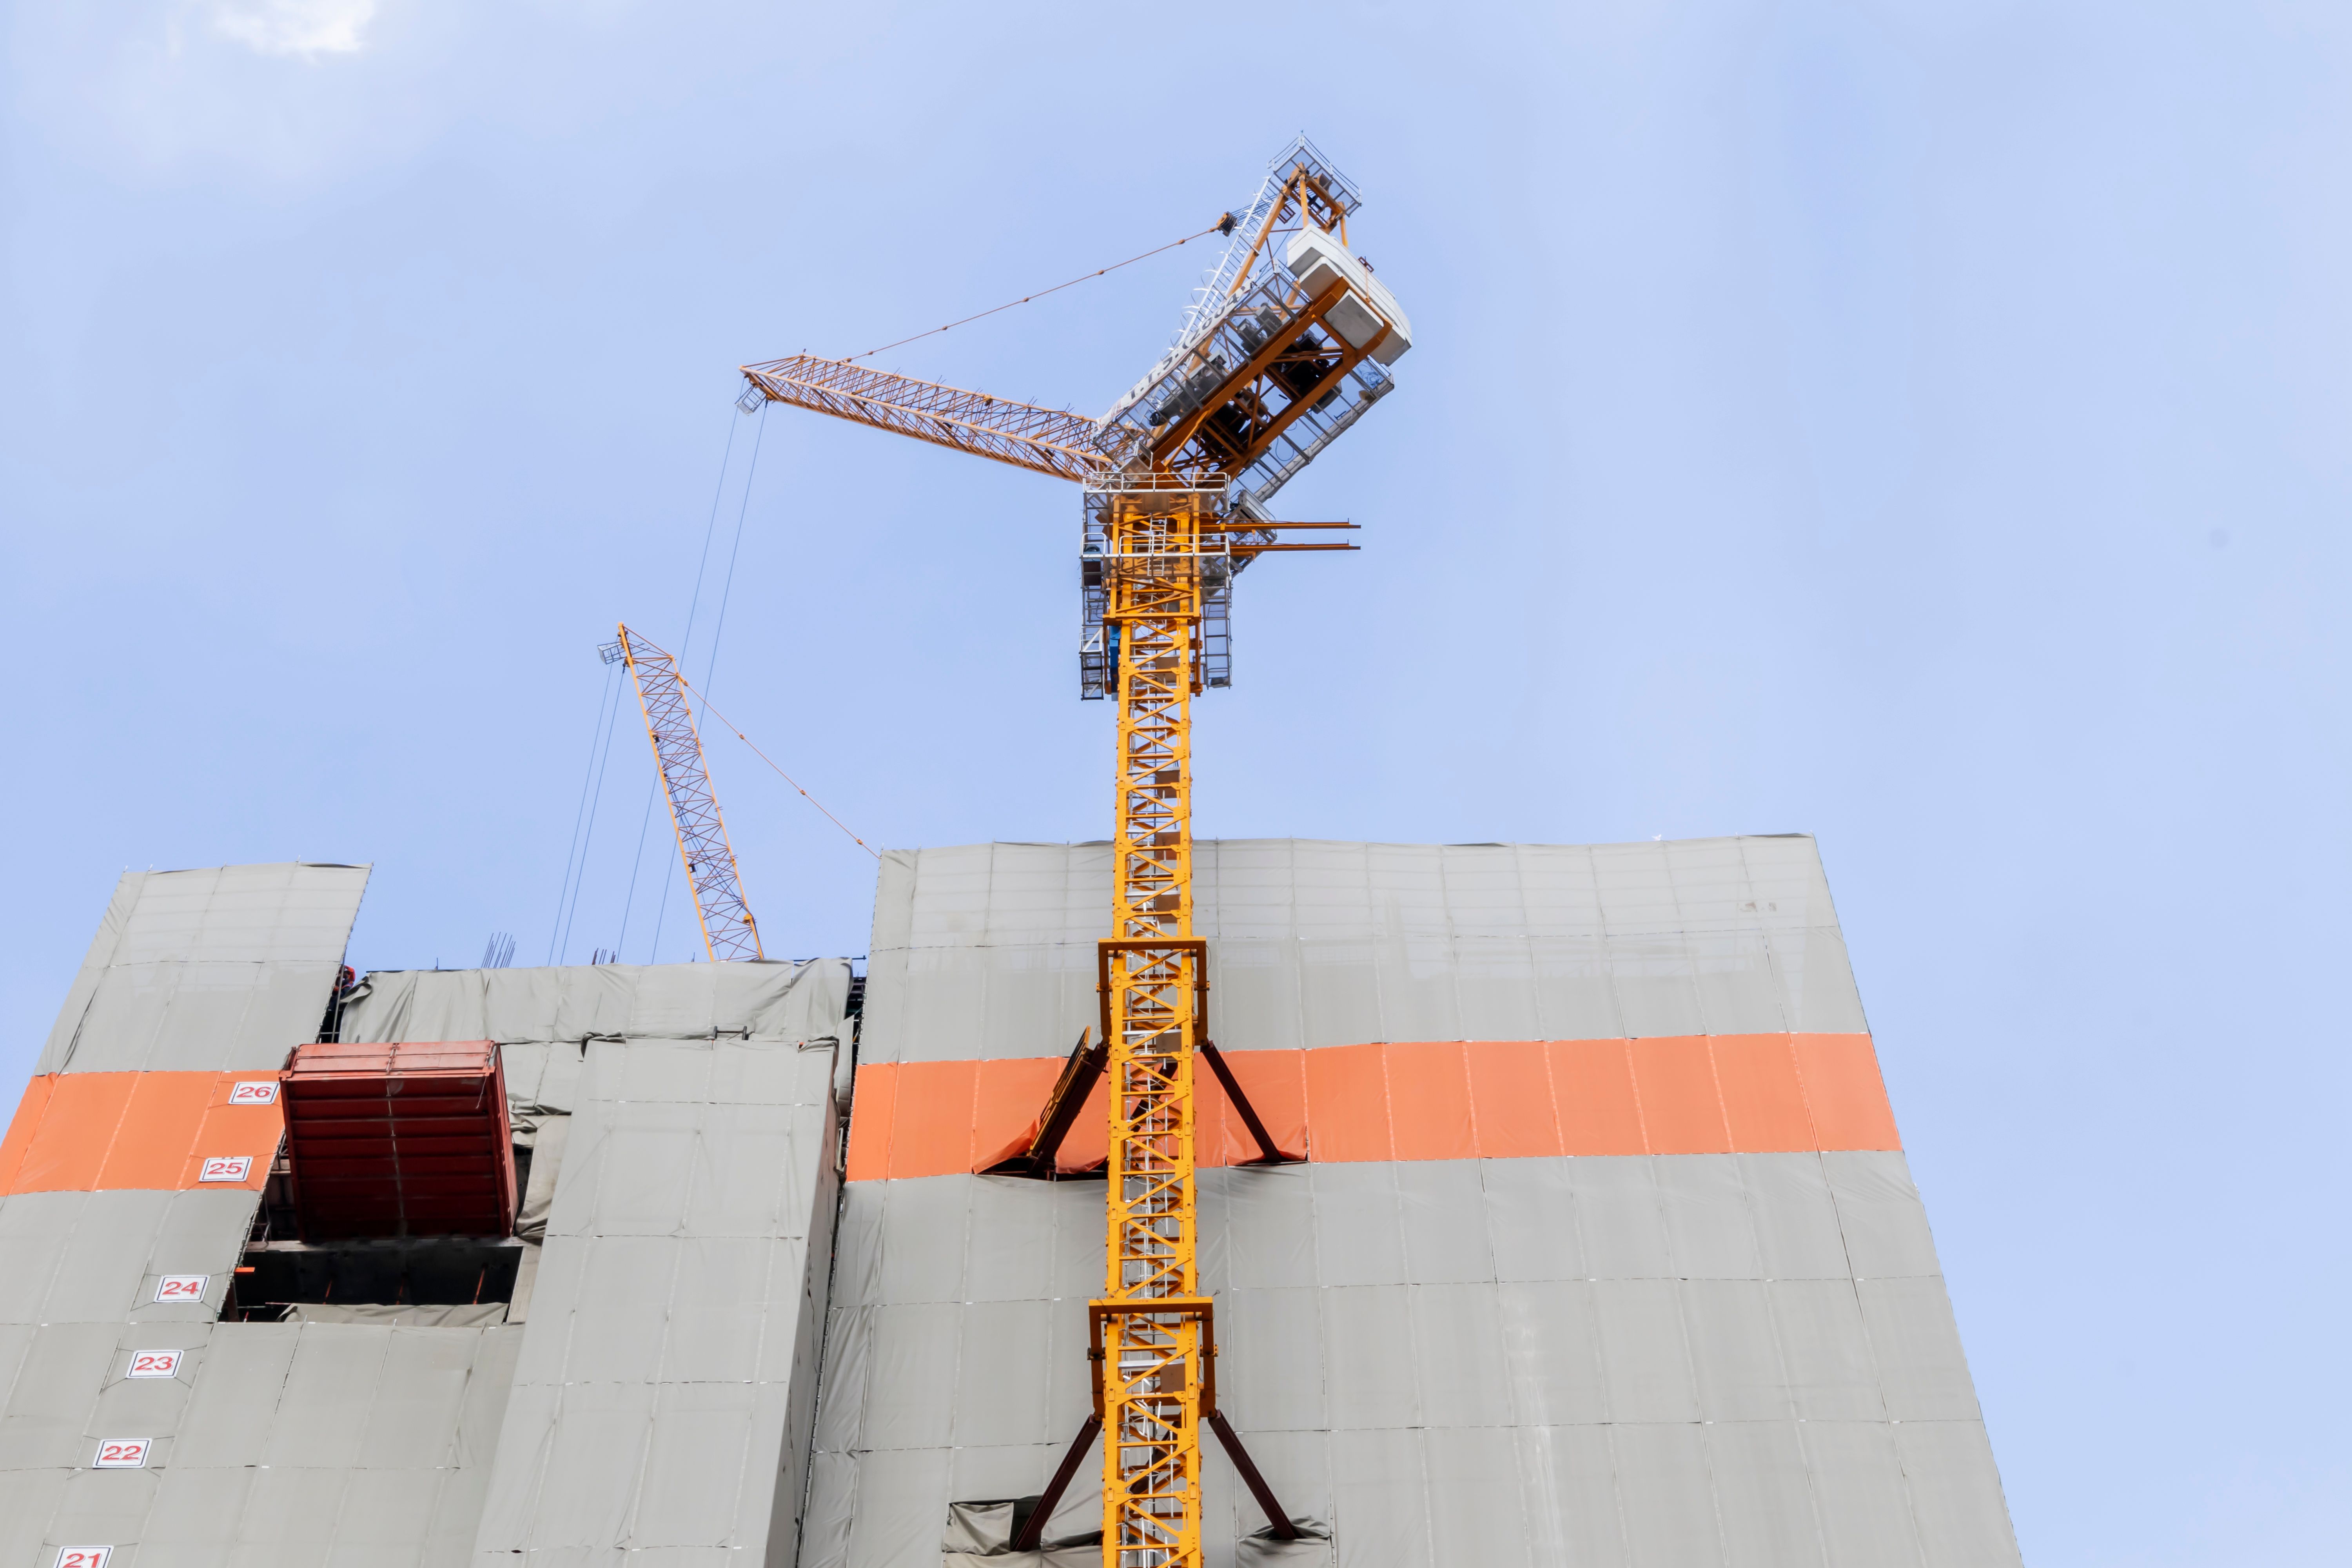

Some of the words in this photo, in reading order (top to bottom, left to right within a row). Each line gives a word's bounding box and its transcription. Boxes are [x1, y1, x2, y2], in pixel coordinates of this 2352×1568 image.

[236, 1087, 271, 1098] 26
[207, 1163, 244, 1174] 25
[163, 1281, 199, 1294] 24
[135, 1357, 173, 1370] 23
[102, 1446, 142, 1460] 22
[63, 1553, 101, 1568] 21
